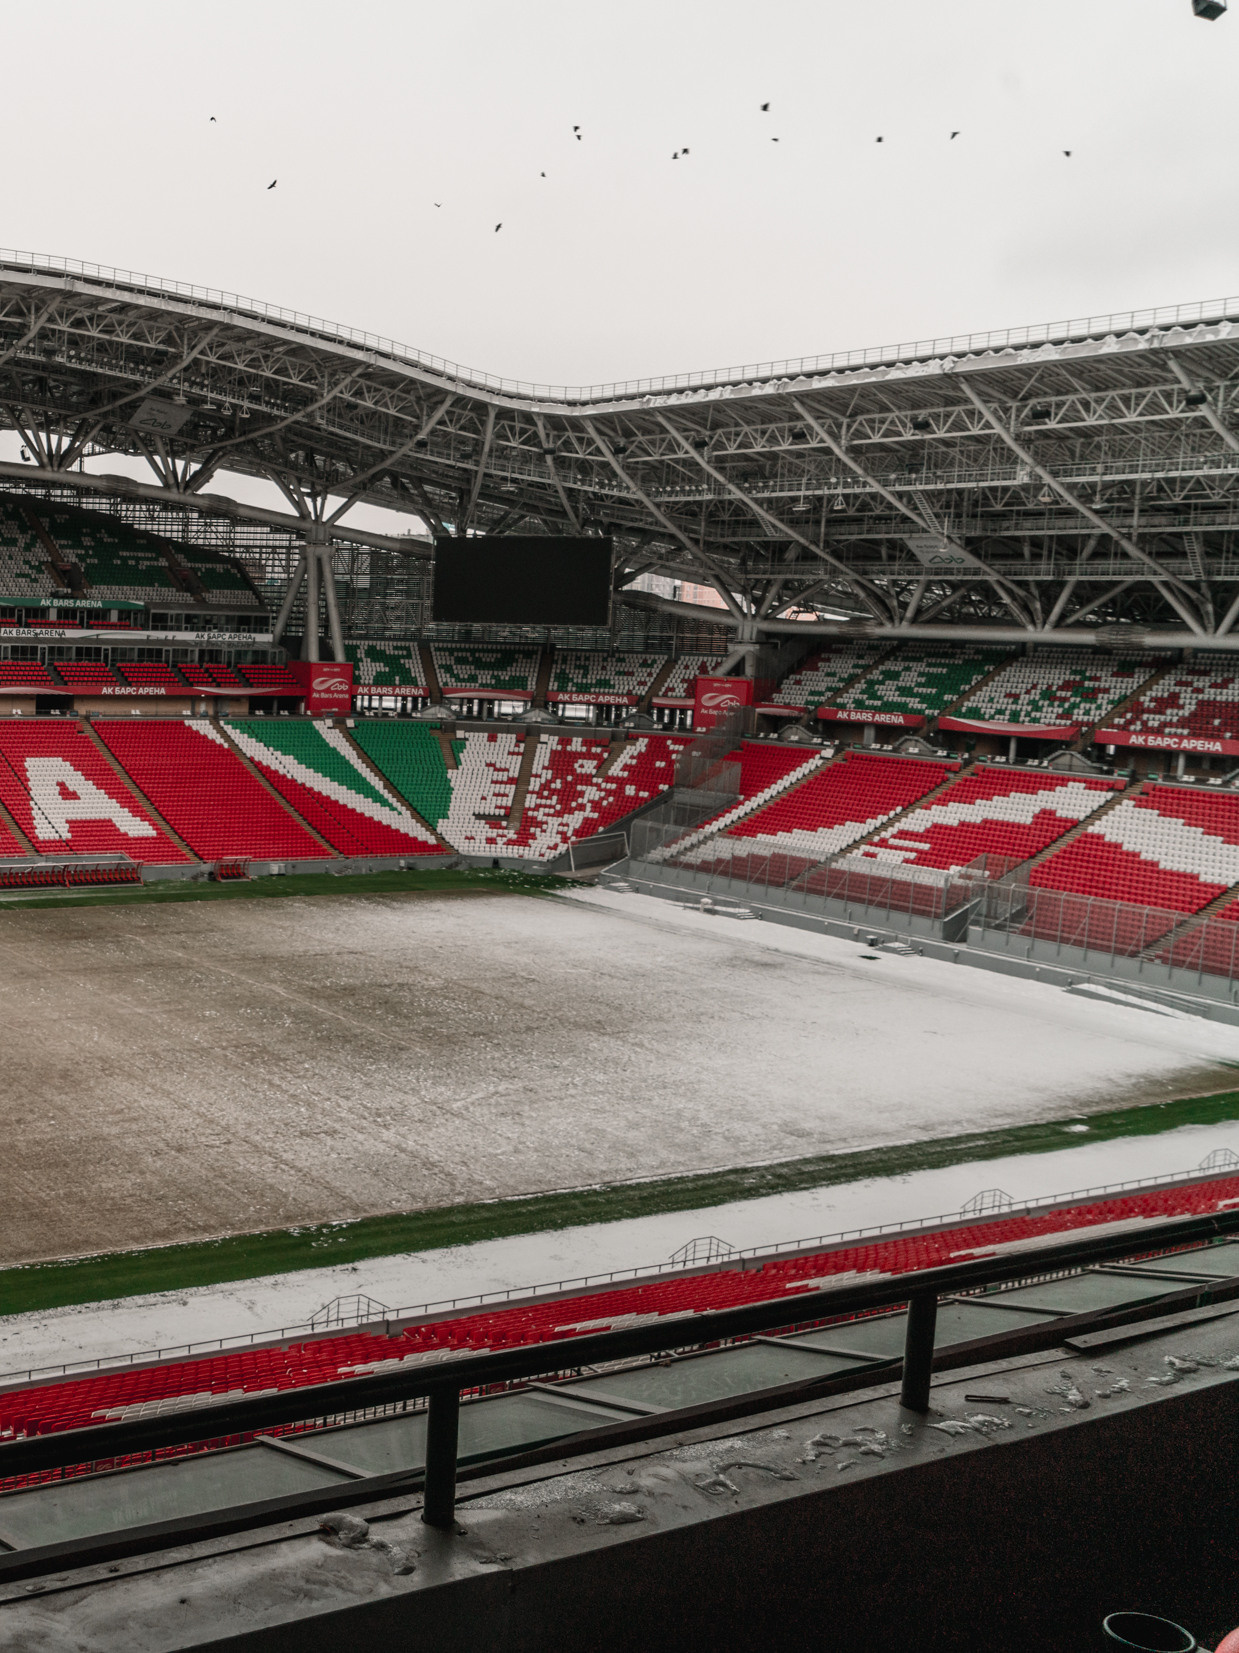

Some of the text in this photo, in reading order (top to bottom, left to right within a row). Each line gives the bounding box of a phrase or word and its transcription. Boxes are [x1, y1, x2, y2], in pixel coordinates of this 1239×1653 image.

[40, 598, 102, 608] AK BARS ARENA
[138, 687, 166, 695] АРЕНА
[572, 694, 596, 702] БАРС
[598, 695, 628, 704] АРЕНА
[837, 711, 904, 724] AK BARS ARENA
[1129, 735, 1222, 752] АК БАРС АРЕНА
